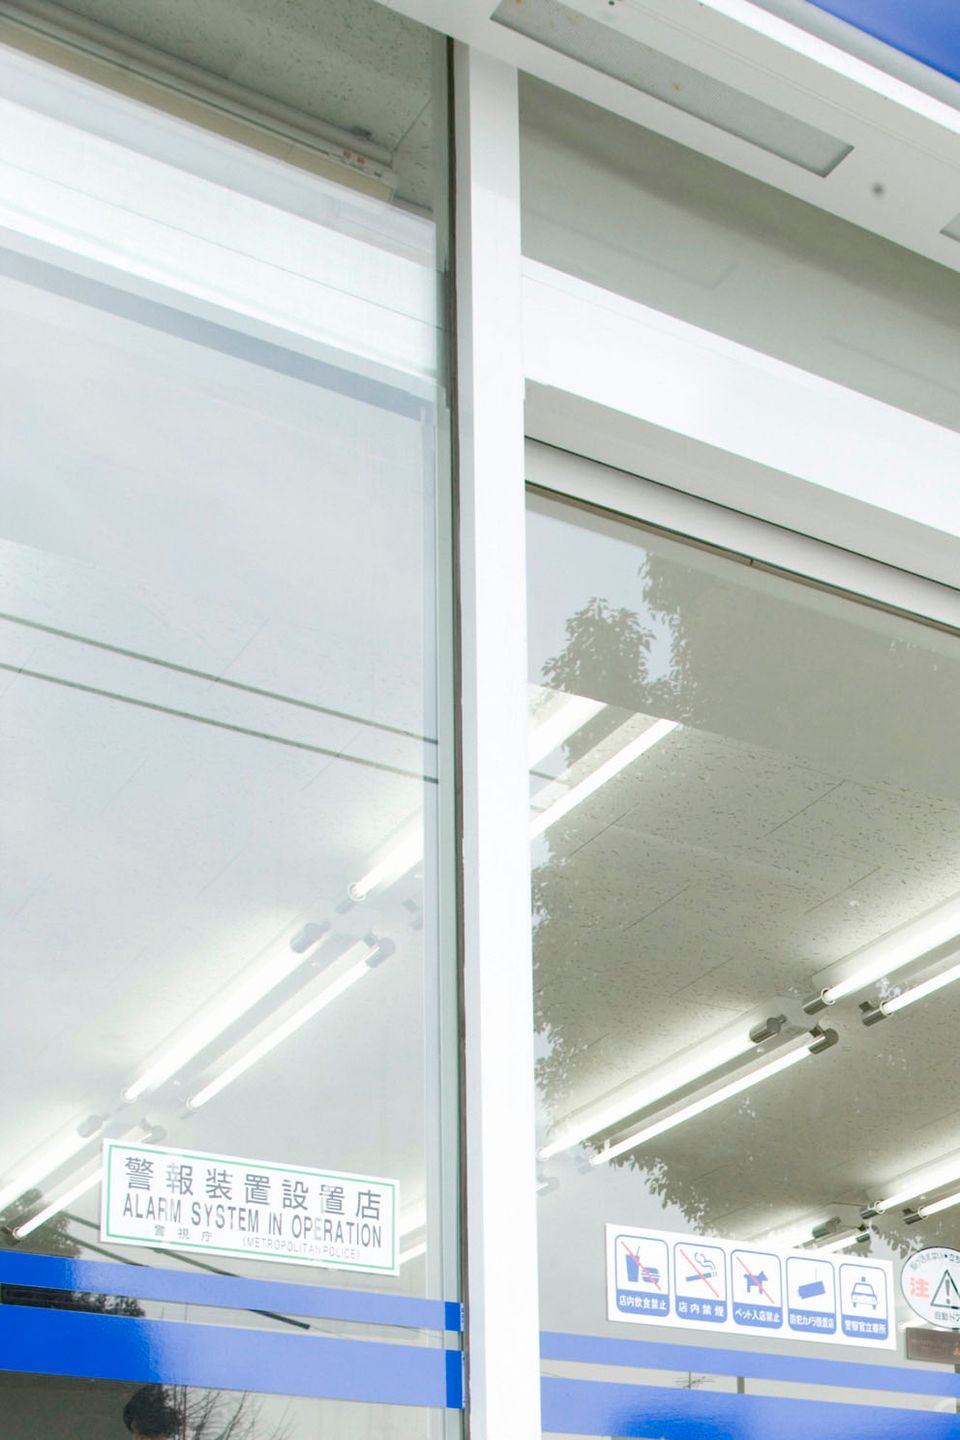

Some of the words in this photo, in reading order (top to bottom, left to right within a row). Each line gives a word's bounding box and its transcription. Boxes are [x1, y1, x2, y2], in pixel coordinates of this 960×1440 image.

[125, 1157, 382, 1221] 警報装置設置店
[123, 1193, 182, 1223] ALARM
[191, 1201, 259, 1233] SYSTEM
[268, 1213, 283, 1236] IN
[291, 1215, 382, 1249] OPERATION
[154, 1224, 212, 1242] 警視庁
[619, 1295, 667, 1310] 店内飲食禁止
[679, 1301, 725, 1317] 店内禁煙
[735, 1308, 781, 1323] ペット入店禁止
[789, 1313, 835, 1329] 防犯カメラ設置店
